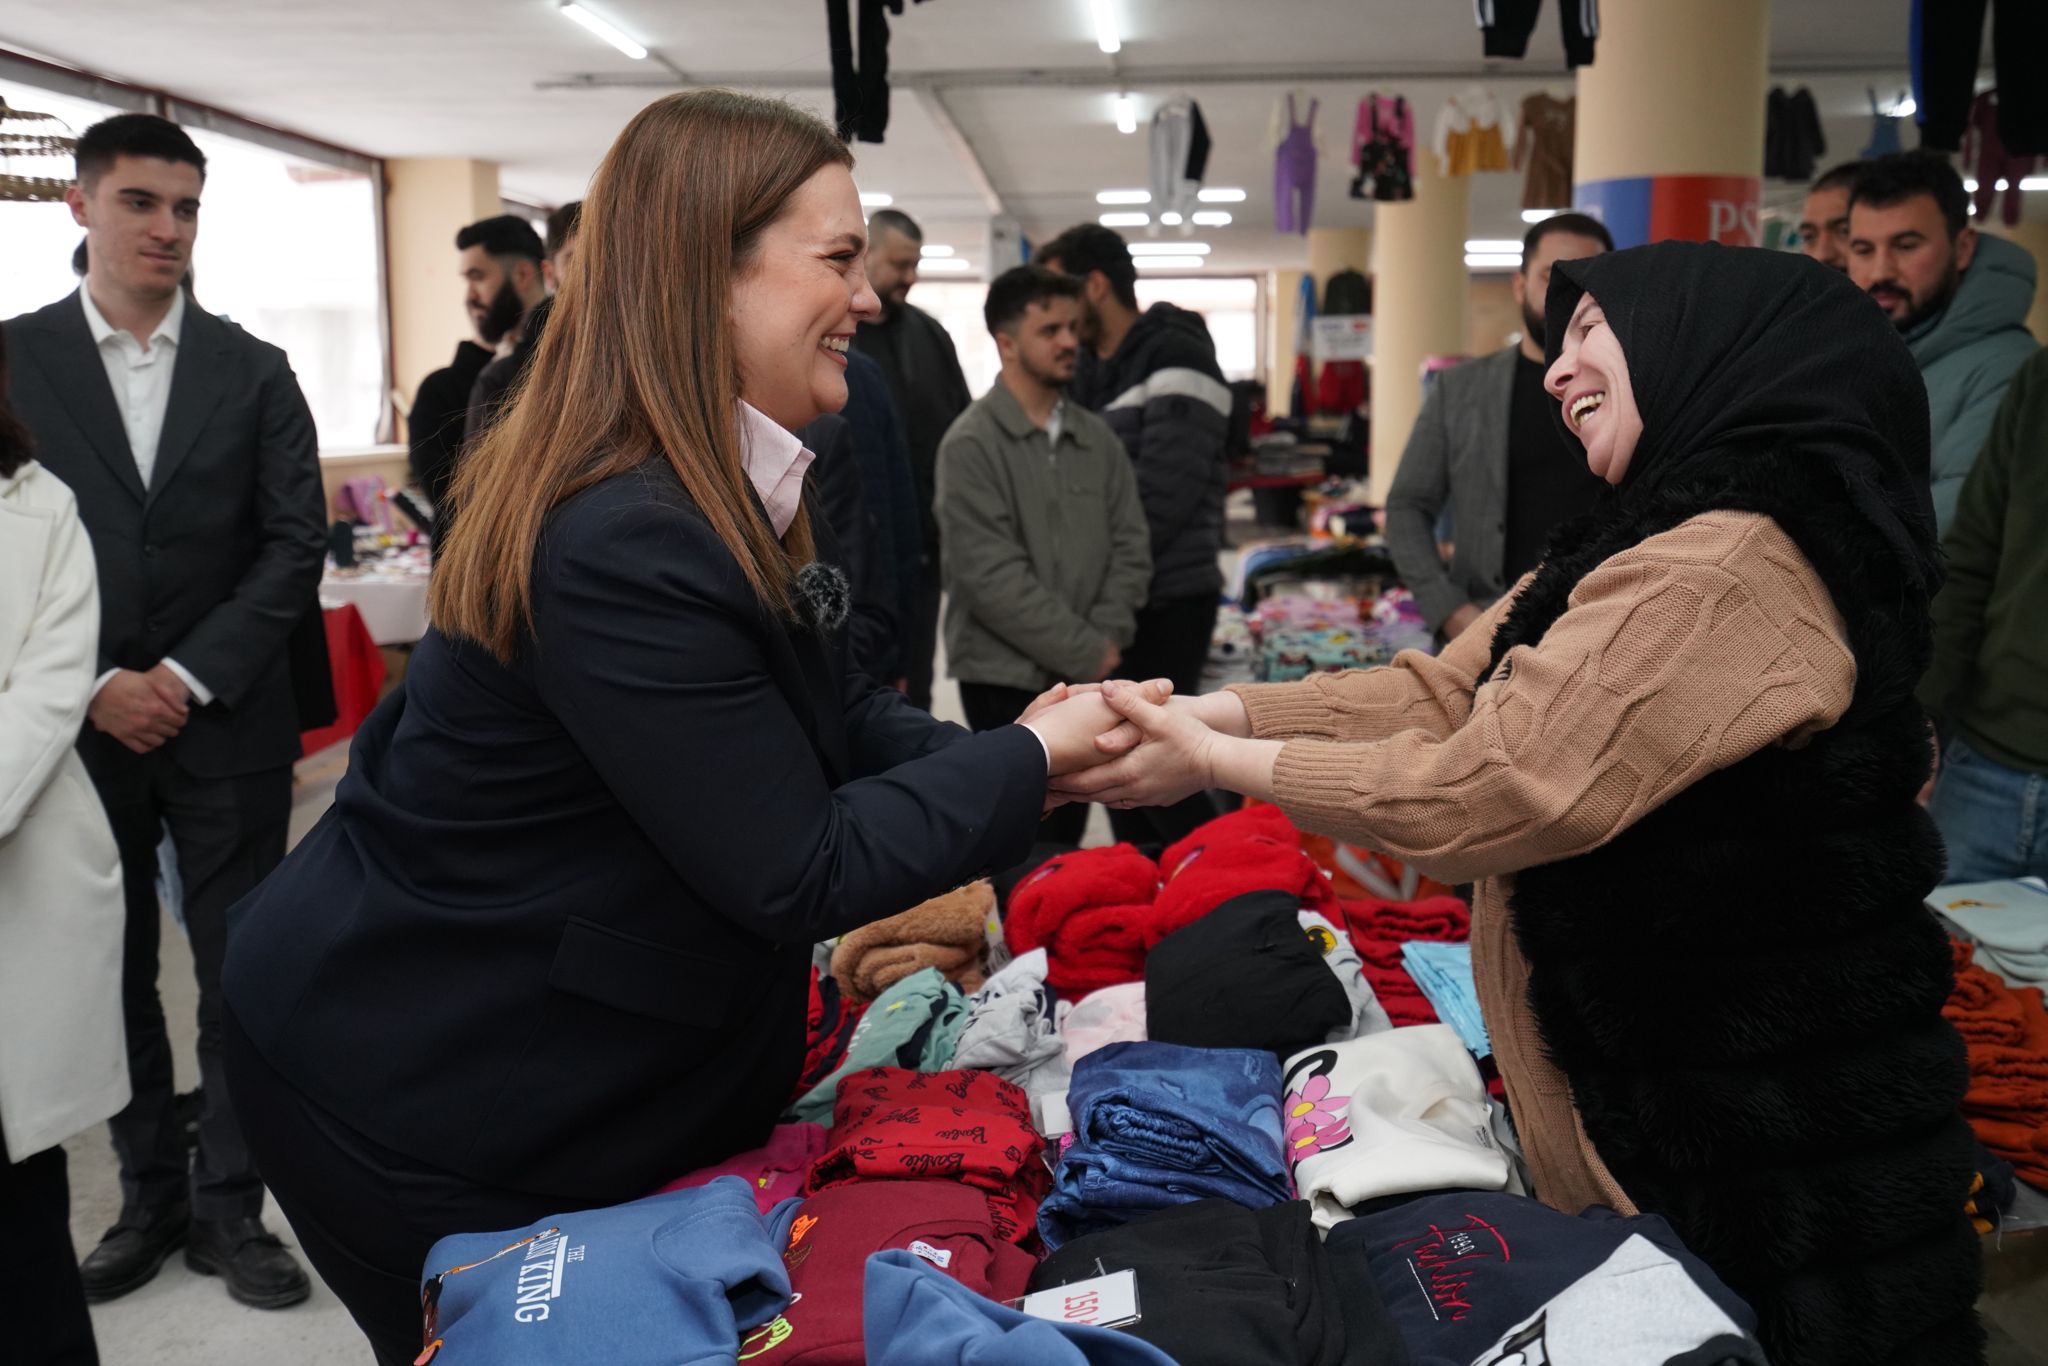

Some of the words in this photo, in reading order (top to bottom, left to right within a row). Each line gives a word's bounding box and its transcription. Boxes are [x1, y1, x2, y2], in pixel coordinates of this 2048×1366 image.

[935, 1126, 988, 1145] Barbie
[900, 1152, 965, 1176] Barbie
[567, 1245, 585, 1263] THE
[1448, 1232, 1475, 1255] 1990
[514, 1259, 554, 1323] KING
[1064, 1291, 1099, 1319] 150
